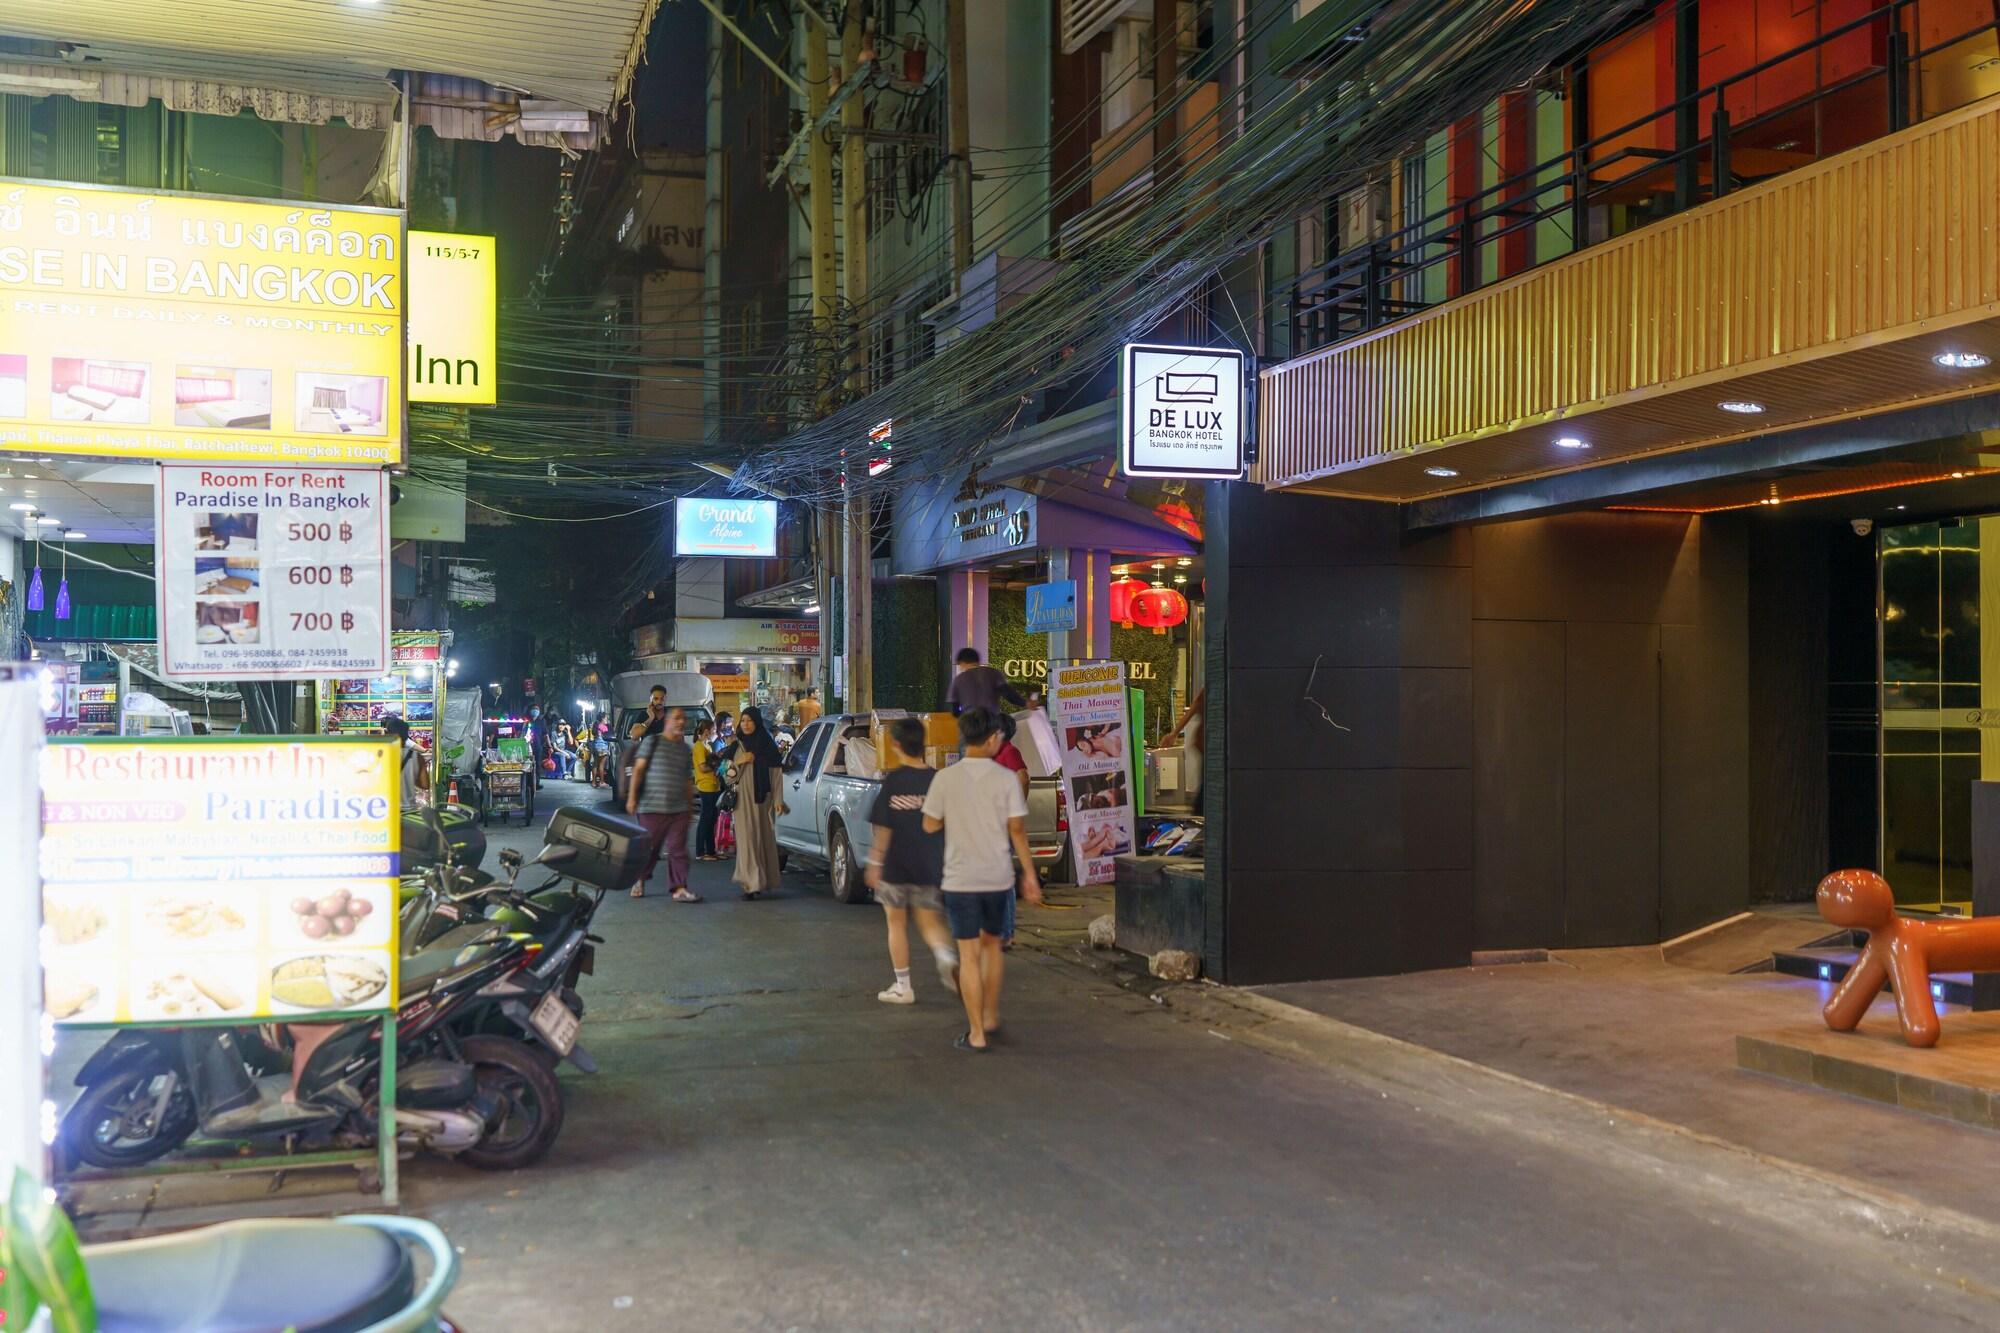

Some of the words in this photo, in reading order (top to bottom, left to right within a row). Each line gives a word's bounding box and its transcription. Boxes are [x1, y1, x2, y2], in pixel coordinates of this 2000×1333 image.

[424, 245, 481, 260] 115/5-7
[80, 251, 129, 291] IN
[145, 256, 395, 310] BANGKOK
[214, 311, 234, 326] &
[244, 317, 395, 336] MONTHLY
[414, 343, 480, 386] Inn
[1149, 408, 1176, 428] DE
[1184, 409, 1223, 430] LUX
[1149, 429, 1193, 439] BANGKOK
[1195, 431, 1223, 441] HOTEL
[282, 443, 342, 458] Bangkok
[345, 446, 389, 459] 10400
[200, 471, 258, 489] Room
[265, 471, 296, 489] For
[301, 471, 346, 489] Rent
[175, 491, 259, 510] Paradise
[265, 492, 283, 509] In
[289, 492, 371, 512] Bangkok
[699, 502, 756, 524] Grand
[287, 521, 332, 543] 500
[709, 523, 743, 542] Alpine
[288, 564, 332, 586] 600
[289, 611, 333, 632] 700
[203, 650, 219, 659] Tel.
[174, 661, 223, 671] Whatsapp
[1059, 665, 1120, 685] WELCOME
[1063, 700, 1083, 711] Thai
[63, 746, 280, 782] Restaurant
[291, 746, 326, 781] In
[58, 803, 78, 820] &
[80, 803, 130, 821] NON
[131, 803, 176, 821] VEG
[206, 789, 388, 821] Paradise
[353, 830, 388, 845] Food
